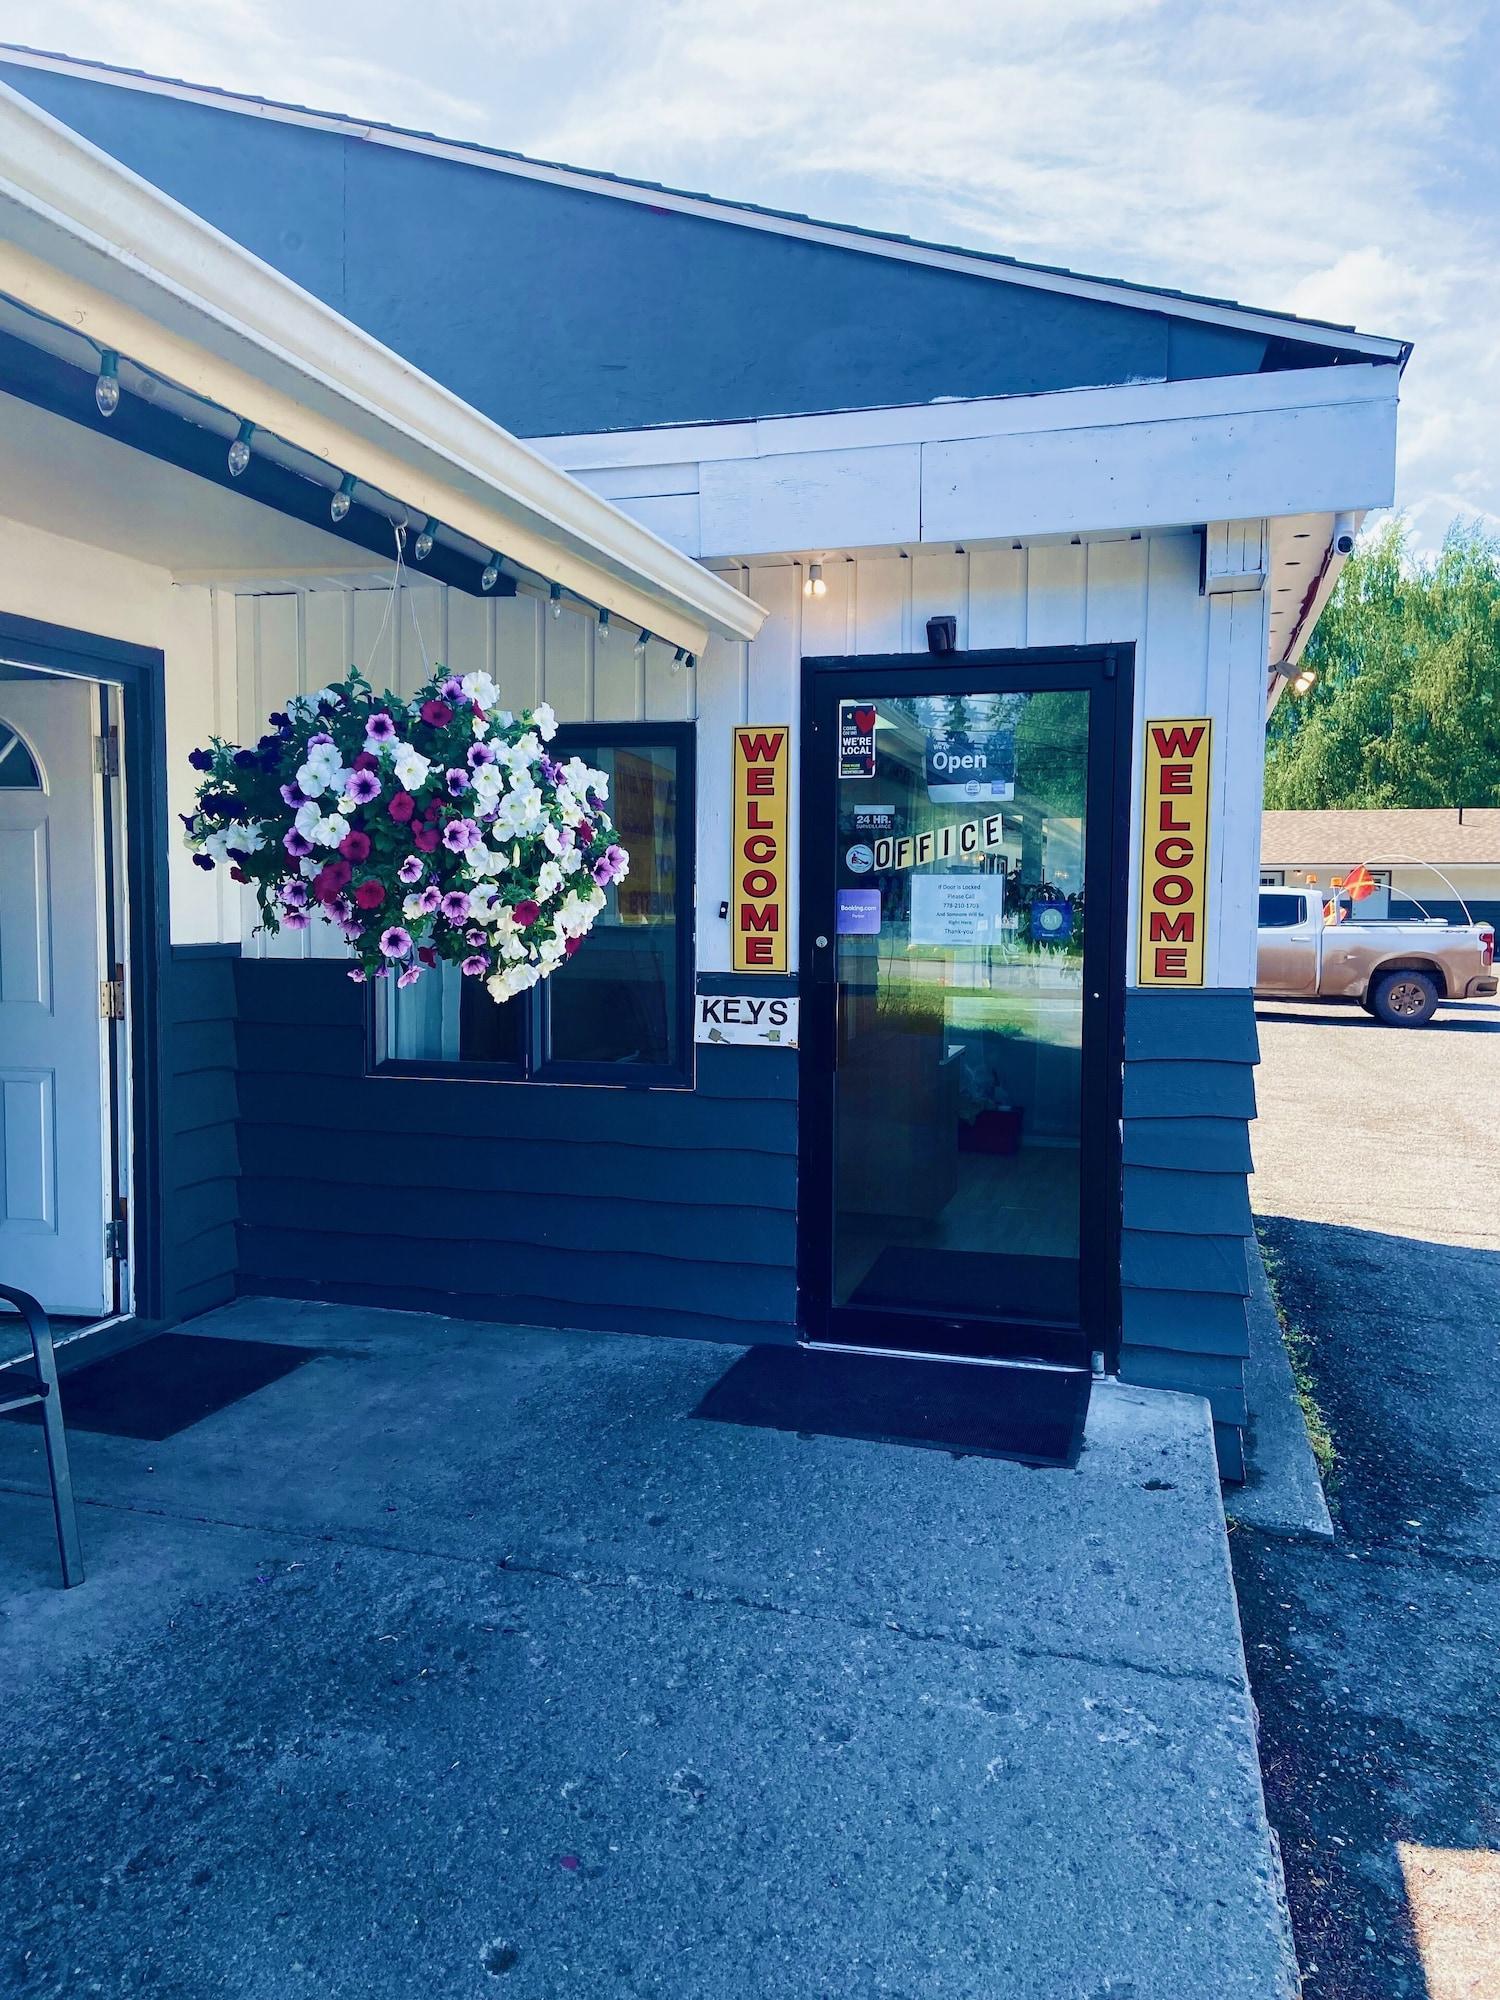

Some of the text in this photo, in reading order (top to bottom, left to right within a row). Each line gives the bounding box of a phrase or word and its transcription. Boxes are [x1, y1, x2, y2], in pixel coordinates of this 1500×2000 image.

[842, 746, 871, 755] LOCAL
[843, 737, 872, 746] WE'RE
[932, 751, 987, 774] Open
[856, 815, 892, 824] 24 HR.
[738, 733, 784, 964] WELCOME
[876, 816, 1000, 868] OFFICE
[1150, 727, 1206, 978] WELCOME
[840, 904, 876, 912] Booking.com
[702, 999, 788, 1026] KEYS
